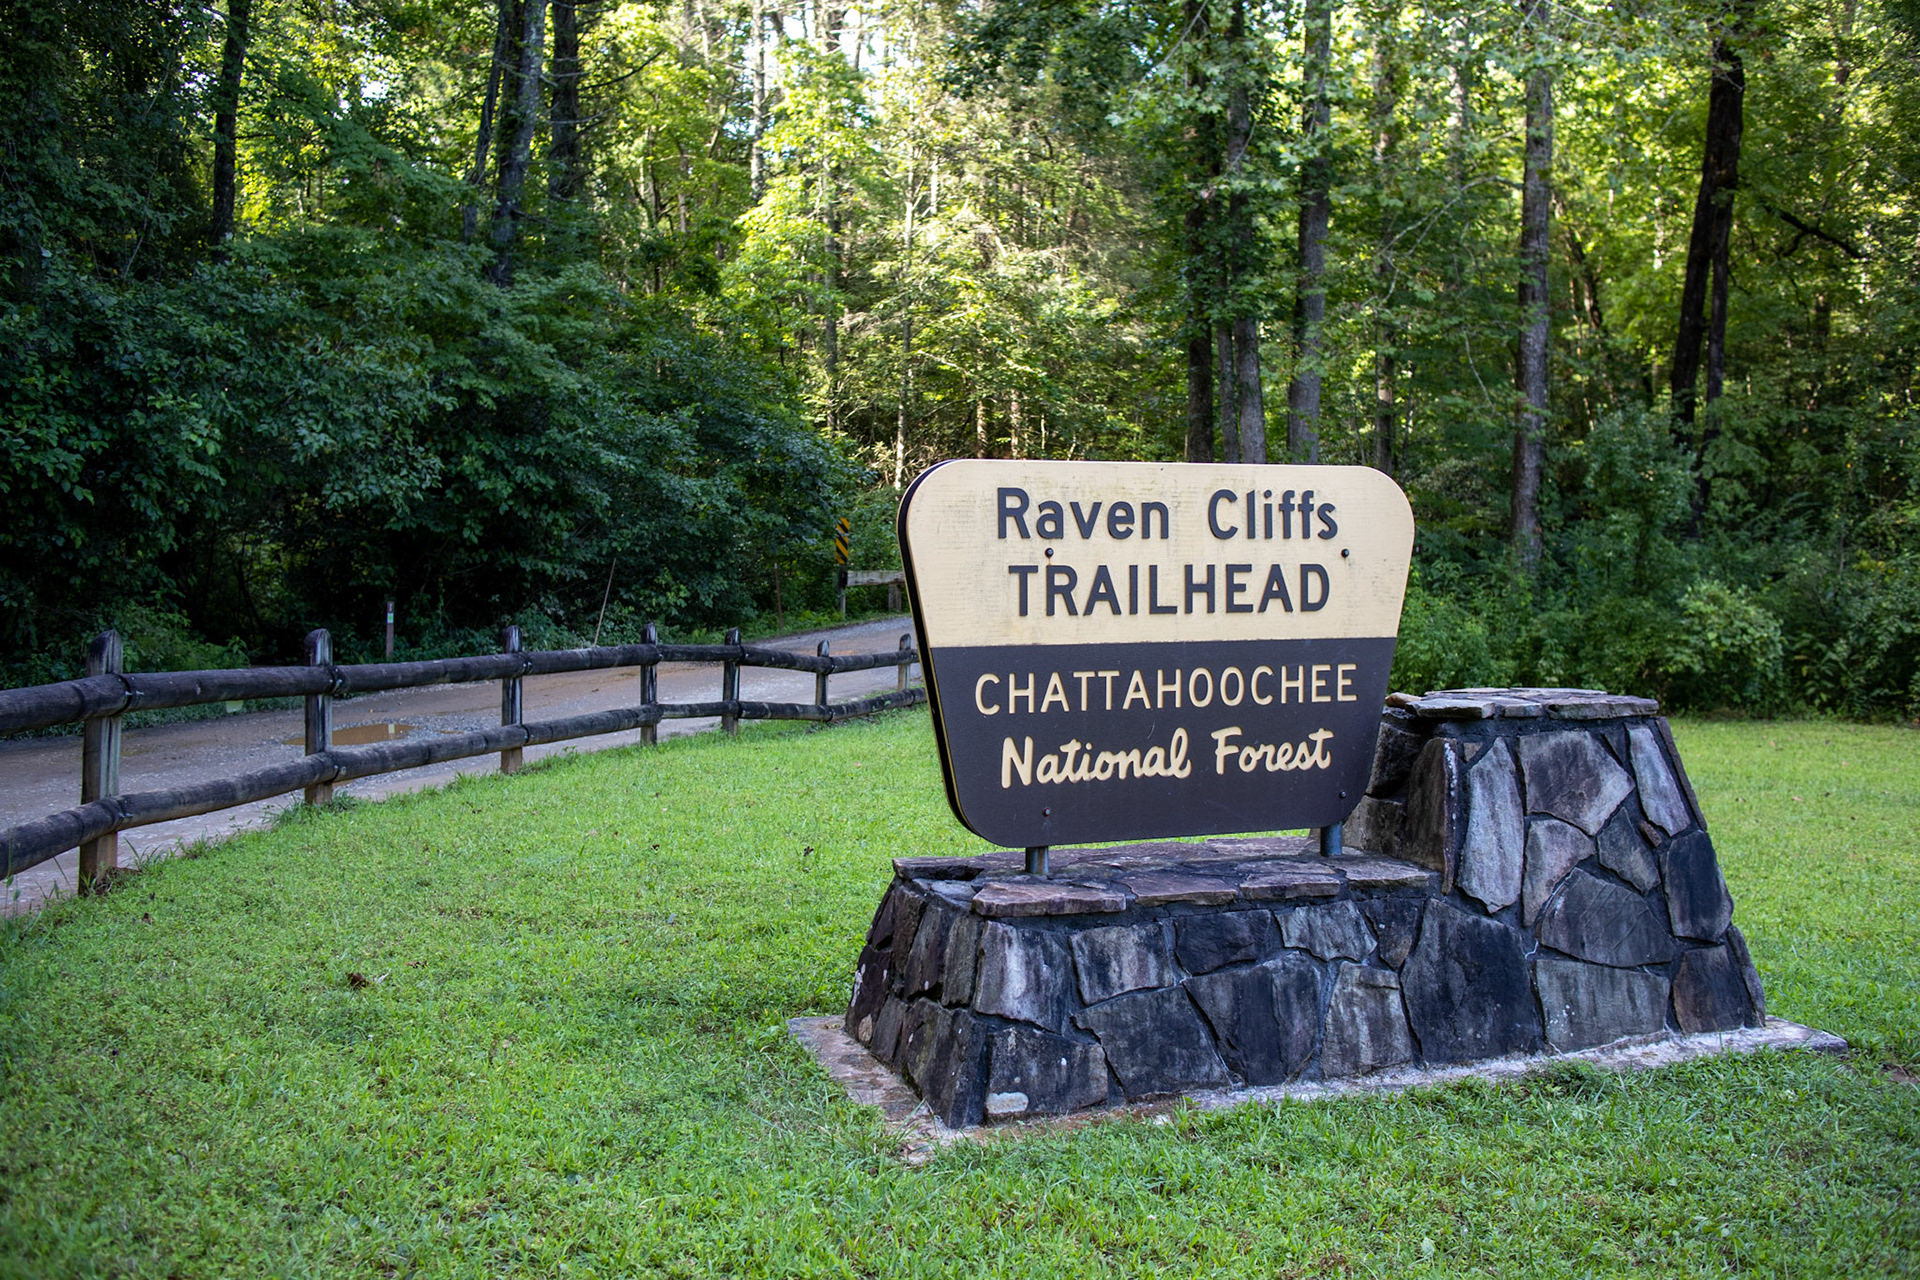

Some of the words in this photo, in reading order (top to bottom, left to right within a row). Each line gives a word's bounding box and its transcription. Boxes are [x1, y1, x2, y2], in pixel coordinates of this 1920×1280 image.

[997, 487, 1170, 540] Raven
[1208, 489, 1338, 540] Cliffs
[1008, 563, 1330, 617] TRAILHEAD
[974, 663, 1358, 715] CHATTAHOOCHEE
[1001, 727, 1192, 789] National
[1211, 726, 1334, 775] Forest
